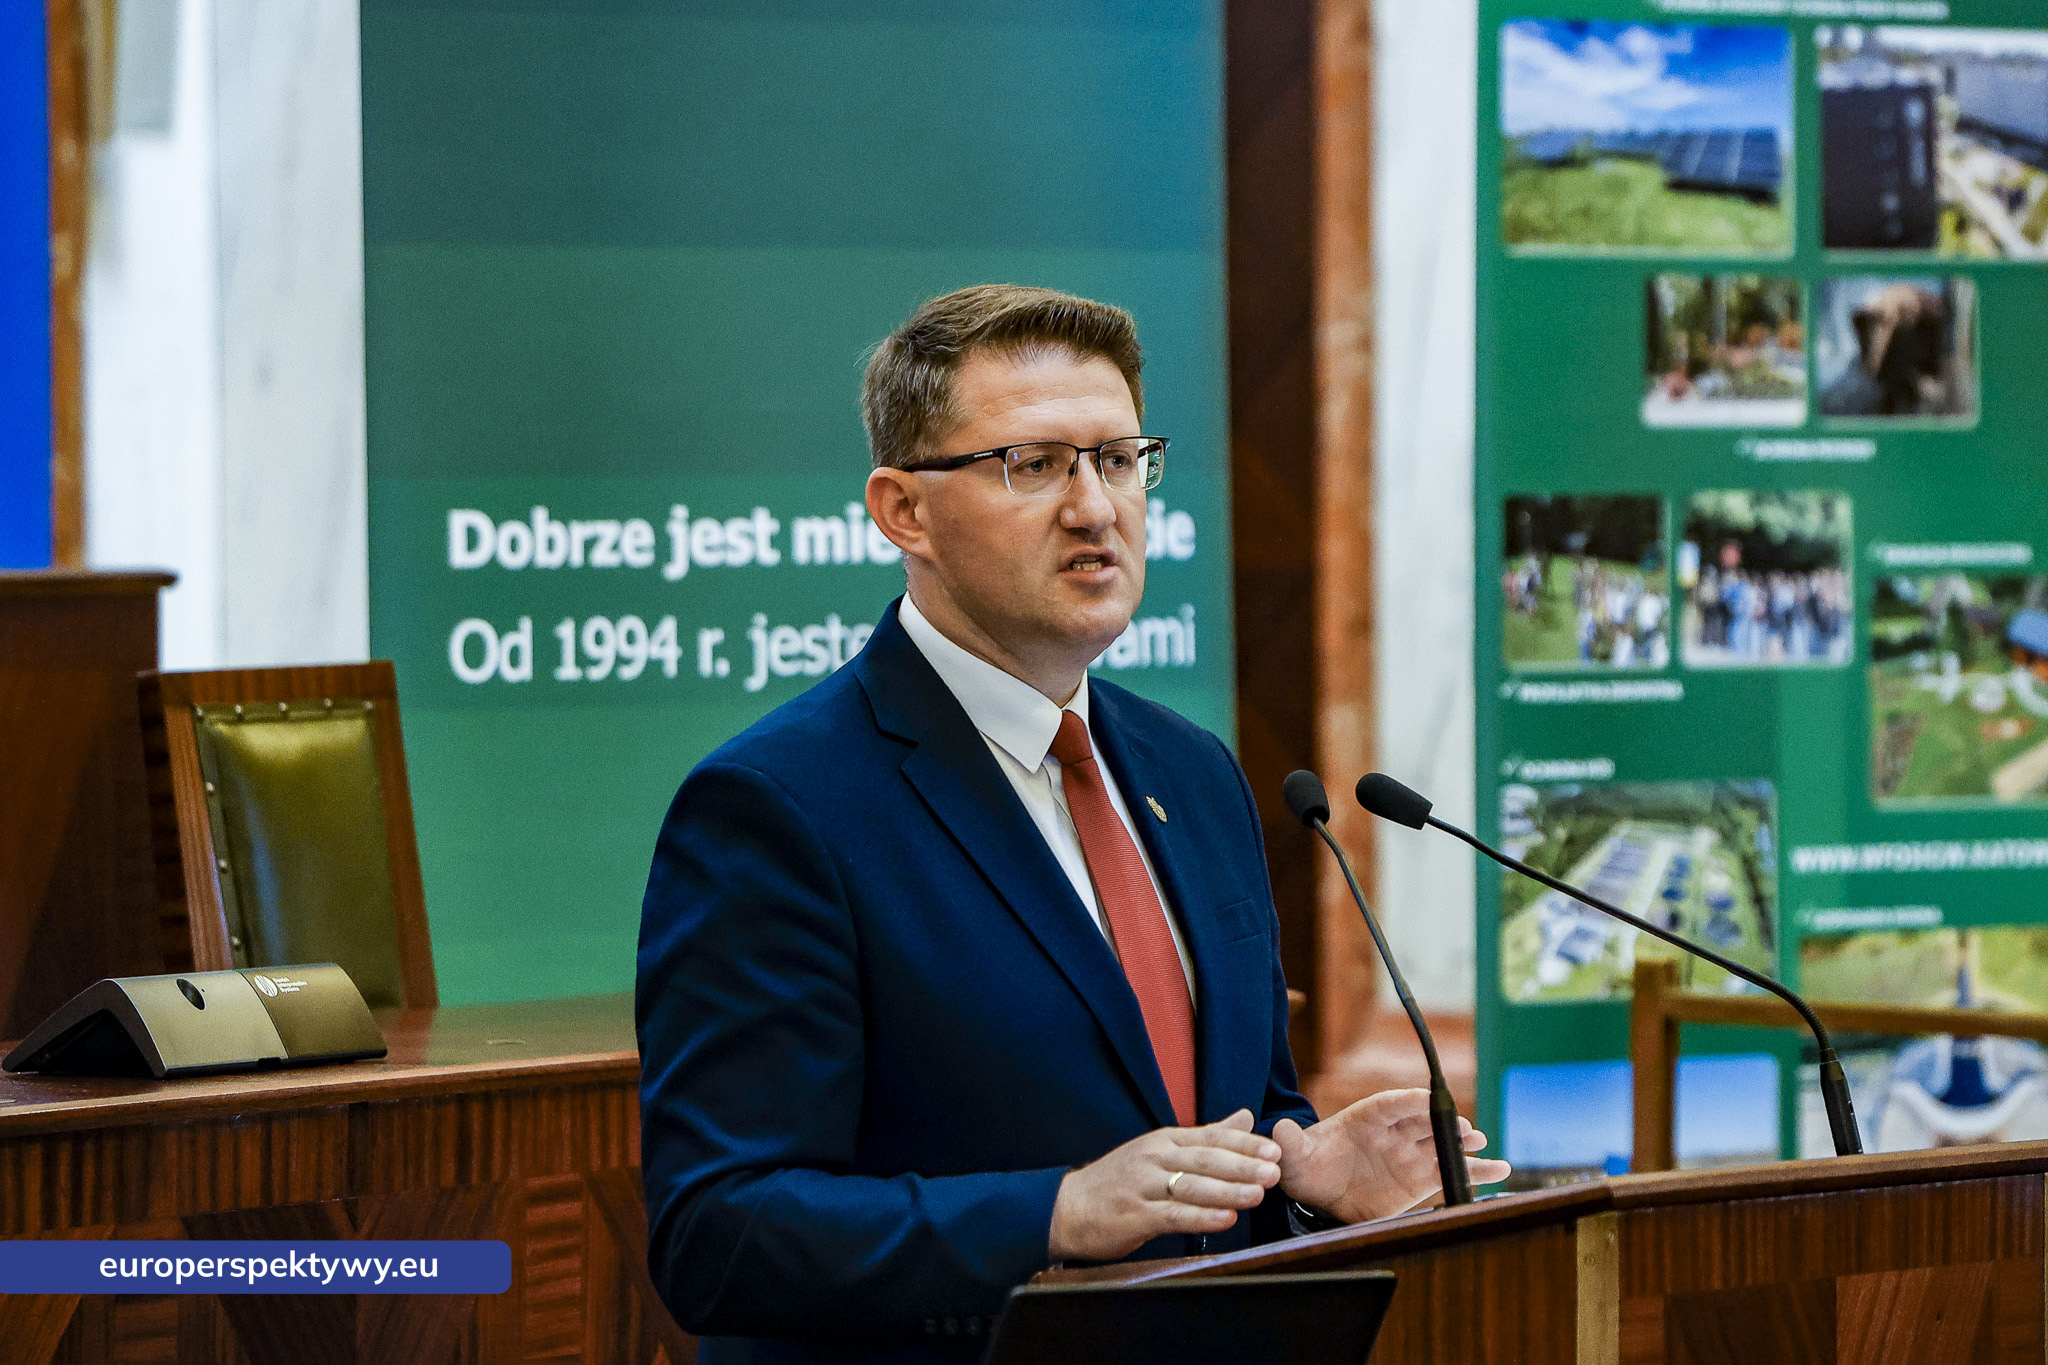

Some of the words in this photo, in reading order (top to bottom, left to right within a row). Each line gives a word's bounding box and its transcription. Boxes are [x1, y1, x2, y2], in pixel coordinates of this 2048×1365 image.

[448, 505, 655, 570] Dobrze
[664, 504, 781, 582] jest
[792, 500, 903, 567] mie
[1146, 496, 1197, 561] ie
[449, 617, 534, 684] Od
[555, 616, 682, 682] 1994
[697, 628, 732, 679] r.
[744, 612, 876, 692] jeste
[1089, 603, 1197, 681] ami
